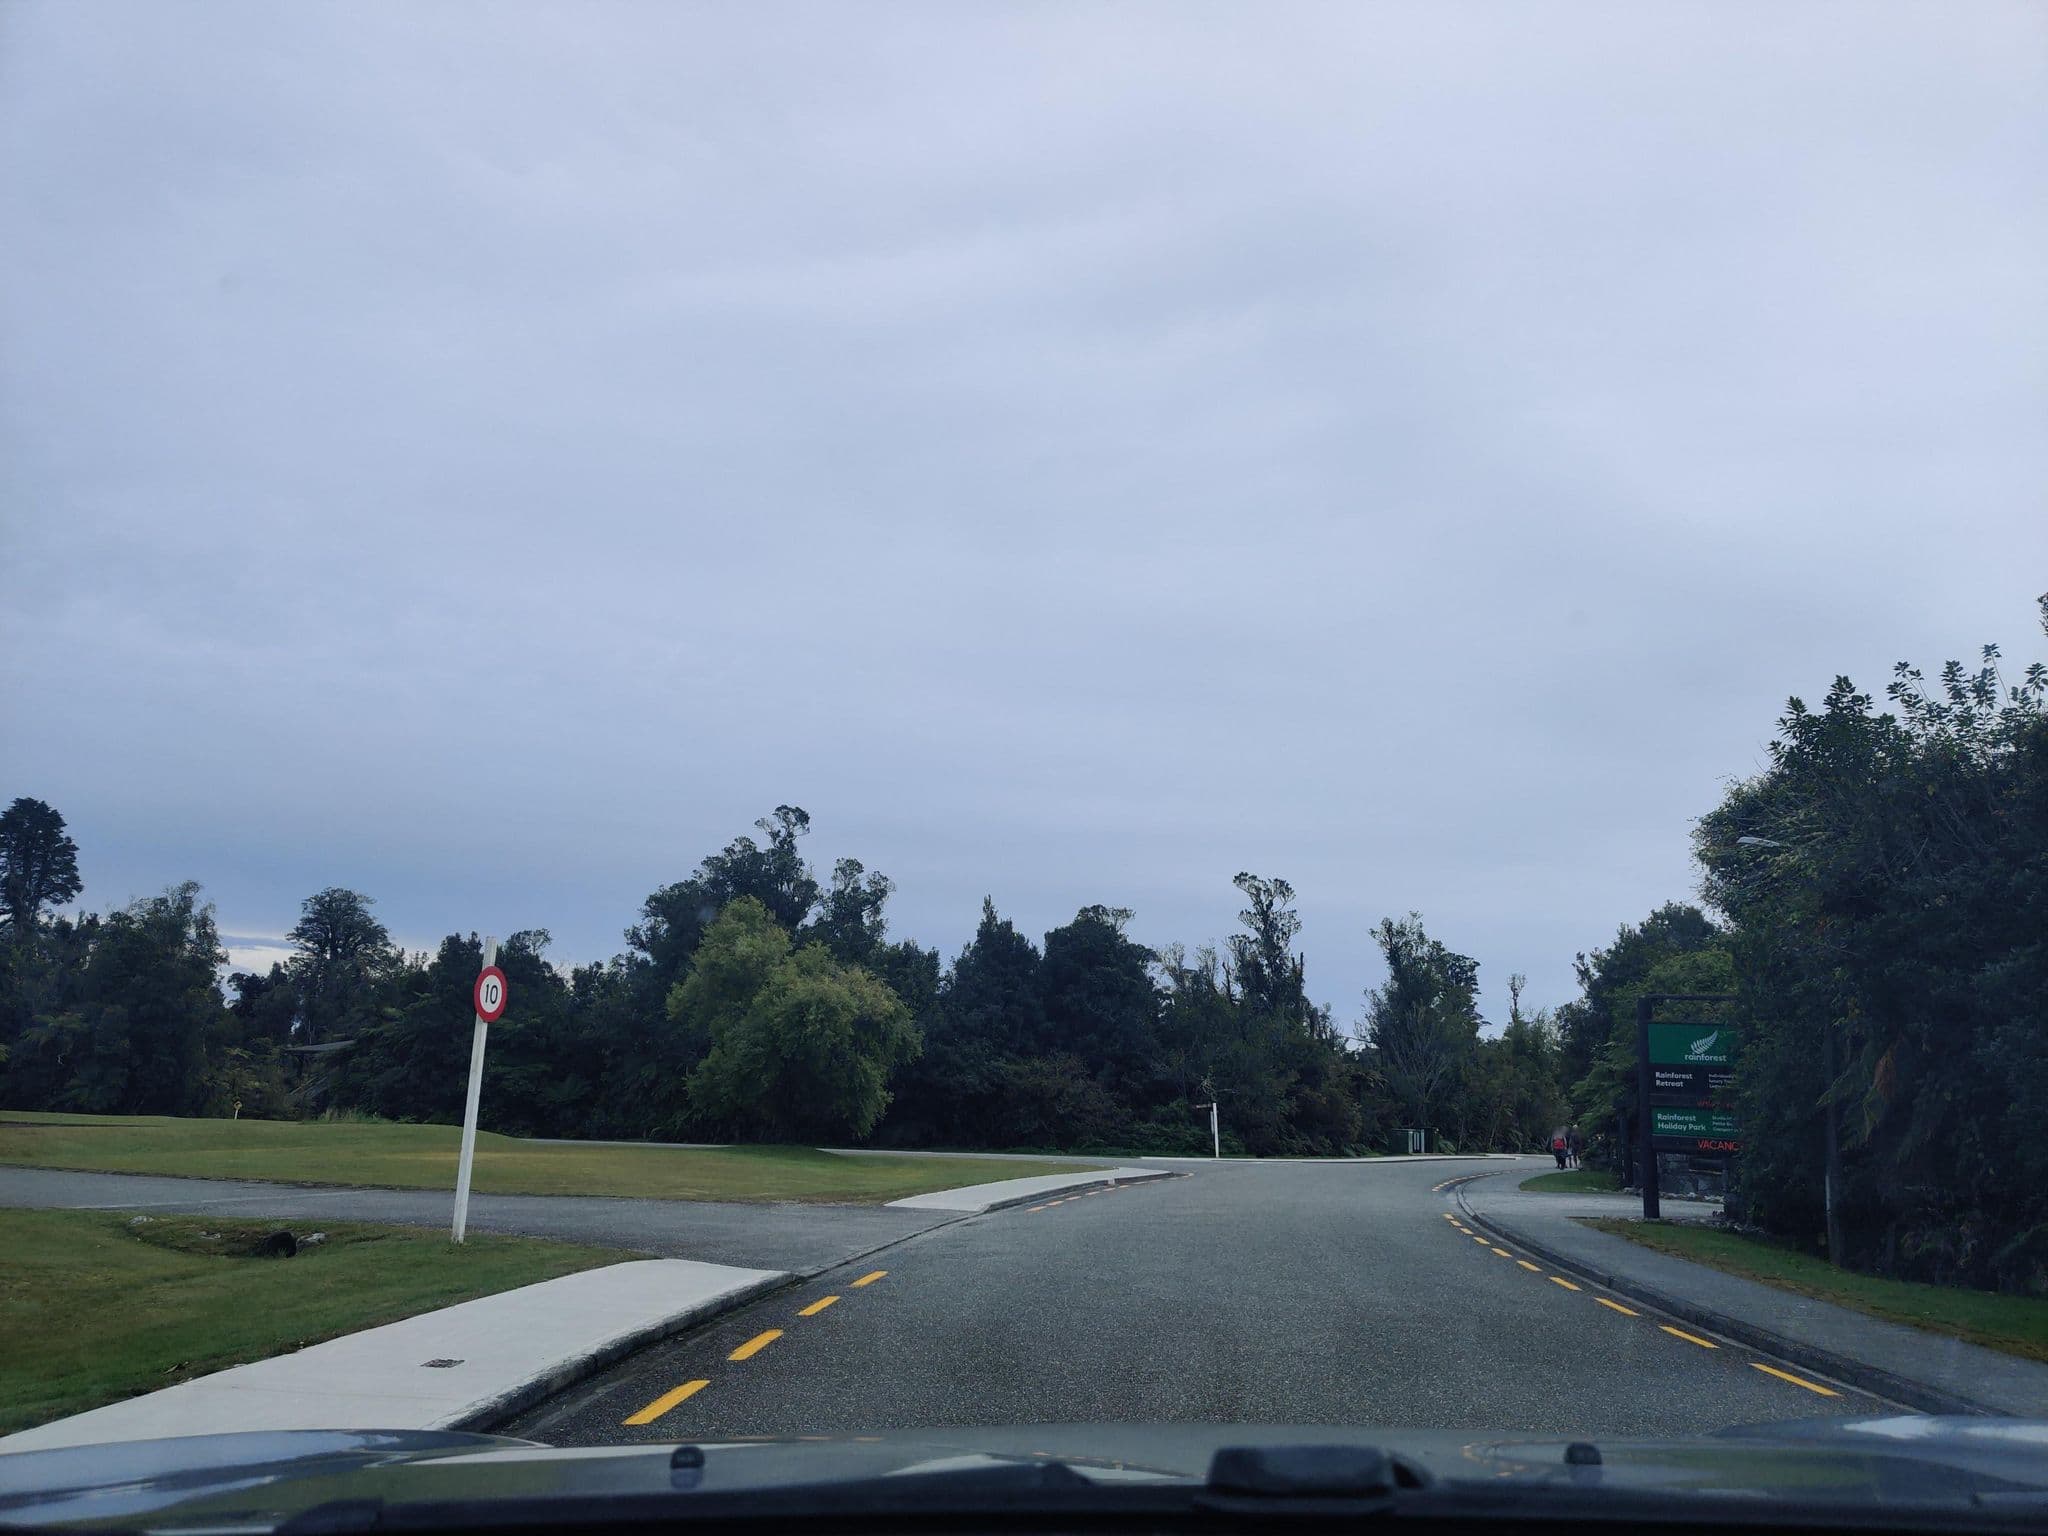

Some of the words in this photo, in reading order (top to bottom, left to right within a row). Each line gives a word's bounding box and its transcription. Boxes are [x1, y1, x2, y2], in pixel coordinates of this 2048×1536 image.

[485, 984, 499, 1004] 10
[1684, 1053, 1727, 1062] rainforest
[1655, 1071, 1693, 1080] Rainforest
[1655, 1079, 1684, 1087] Retreat
[1657, 1113, 1697, 1122] Rainforest
[1657, 1122, 1687, 1131] Holiday
[1688, 1123, 1706, 1131] Park
